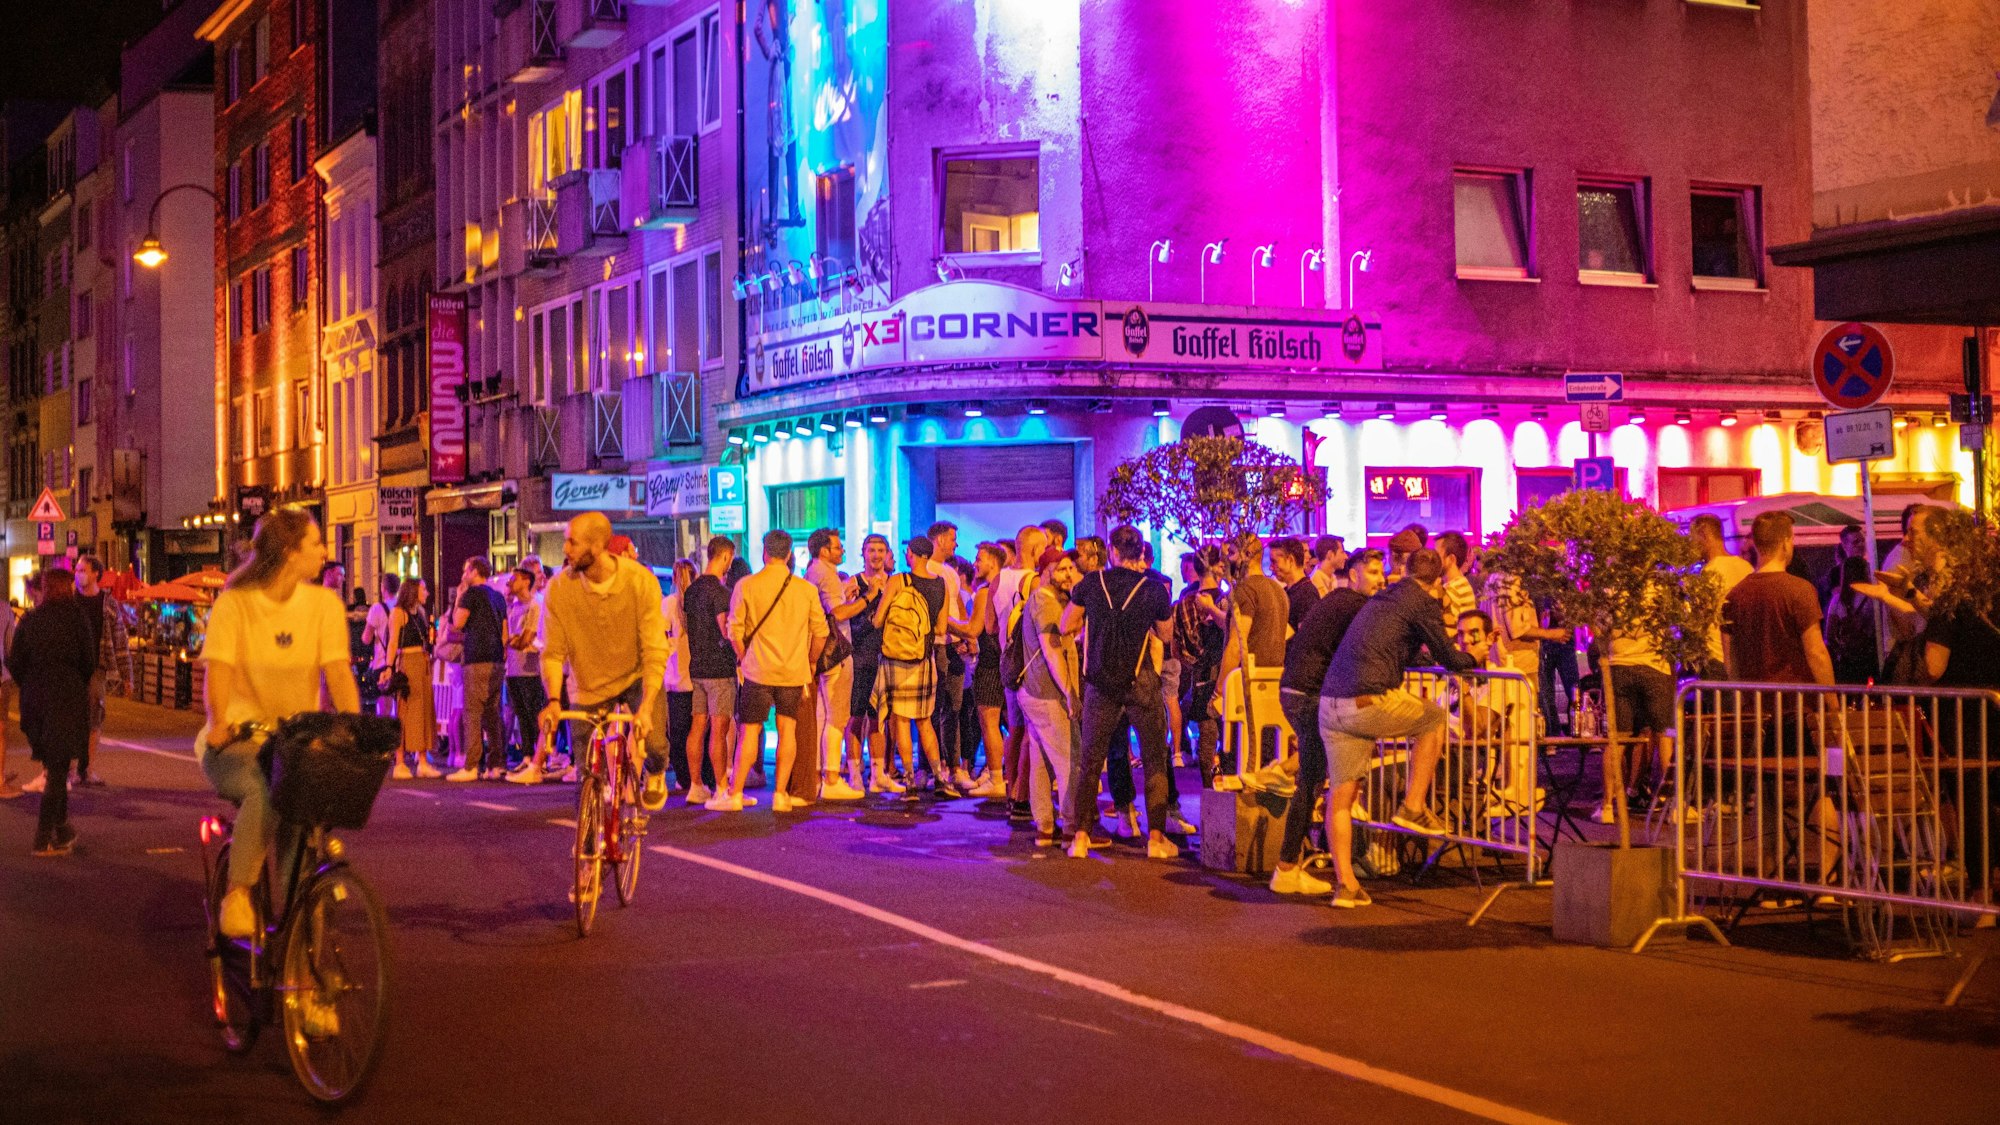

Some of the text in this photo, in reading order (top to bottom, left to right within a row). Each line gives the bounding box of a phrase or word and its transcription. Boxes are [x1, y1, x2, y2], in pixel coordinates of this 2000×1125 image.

[432, 321, 455, 339] die
[911, 312, 1101, 342] CORNER
[1125, 326, 1147, 337] Gaffel
[1173, 325, 1322, 363] Gaffel Kölsch
[772, 348, 799, 380] Gaffel
[802, 341, 834, 375] Kölsch
[1569, 384, 1607, 393] Einbahnstraße
[717, 472, 735, 499] P
[1581, 463, 1602, 488] P
[381, 487, 412, 499] Kölsch
[389, 505, 412, 518] to go
